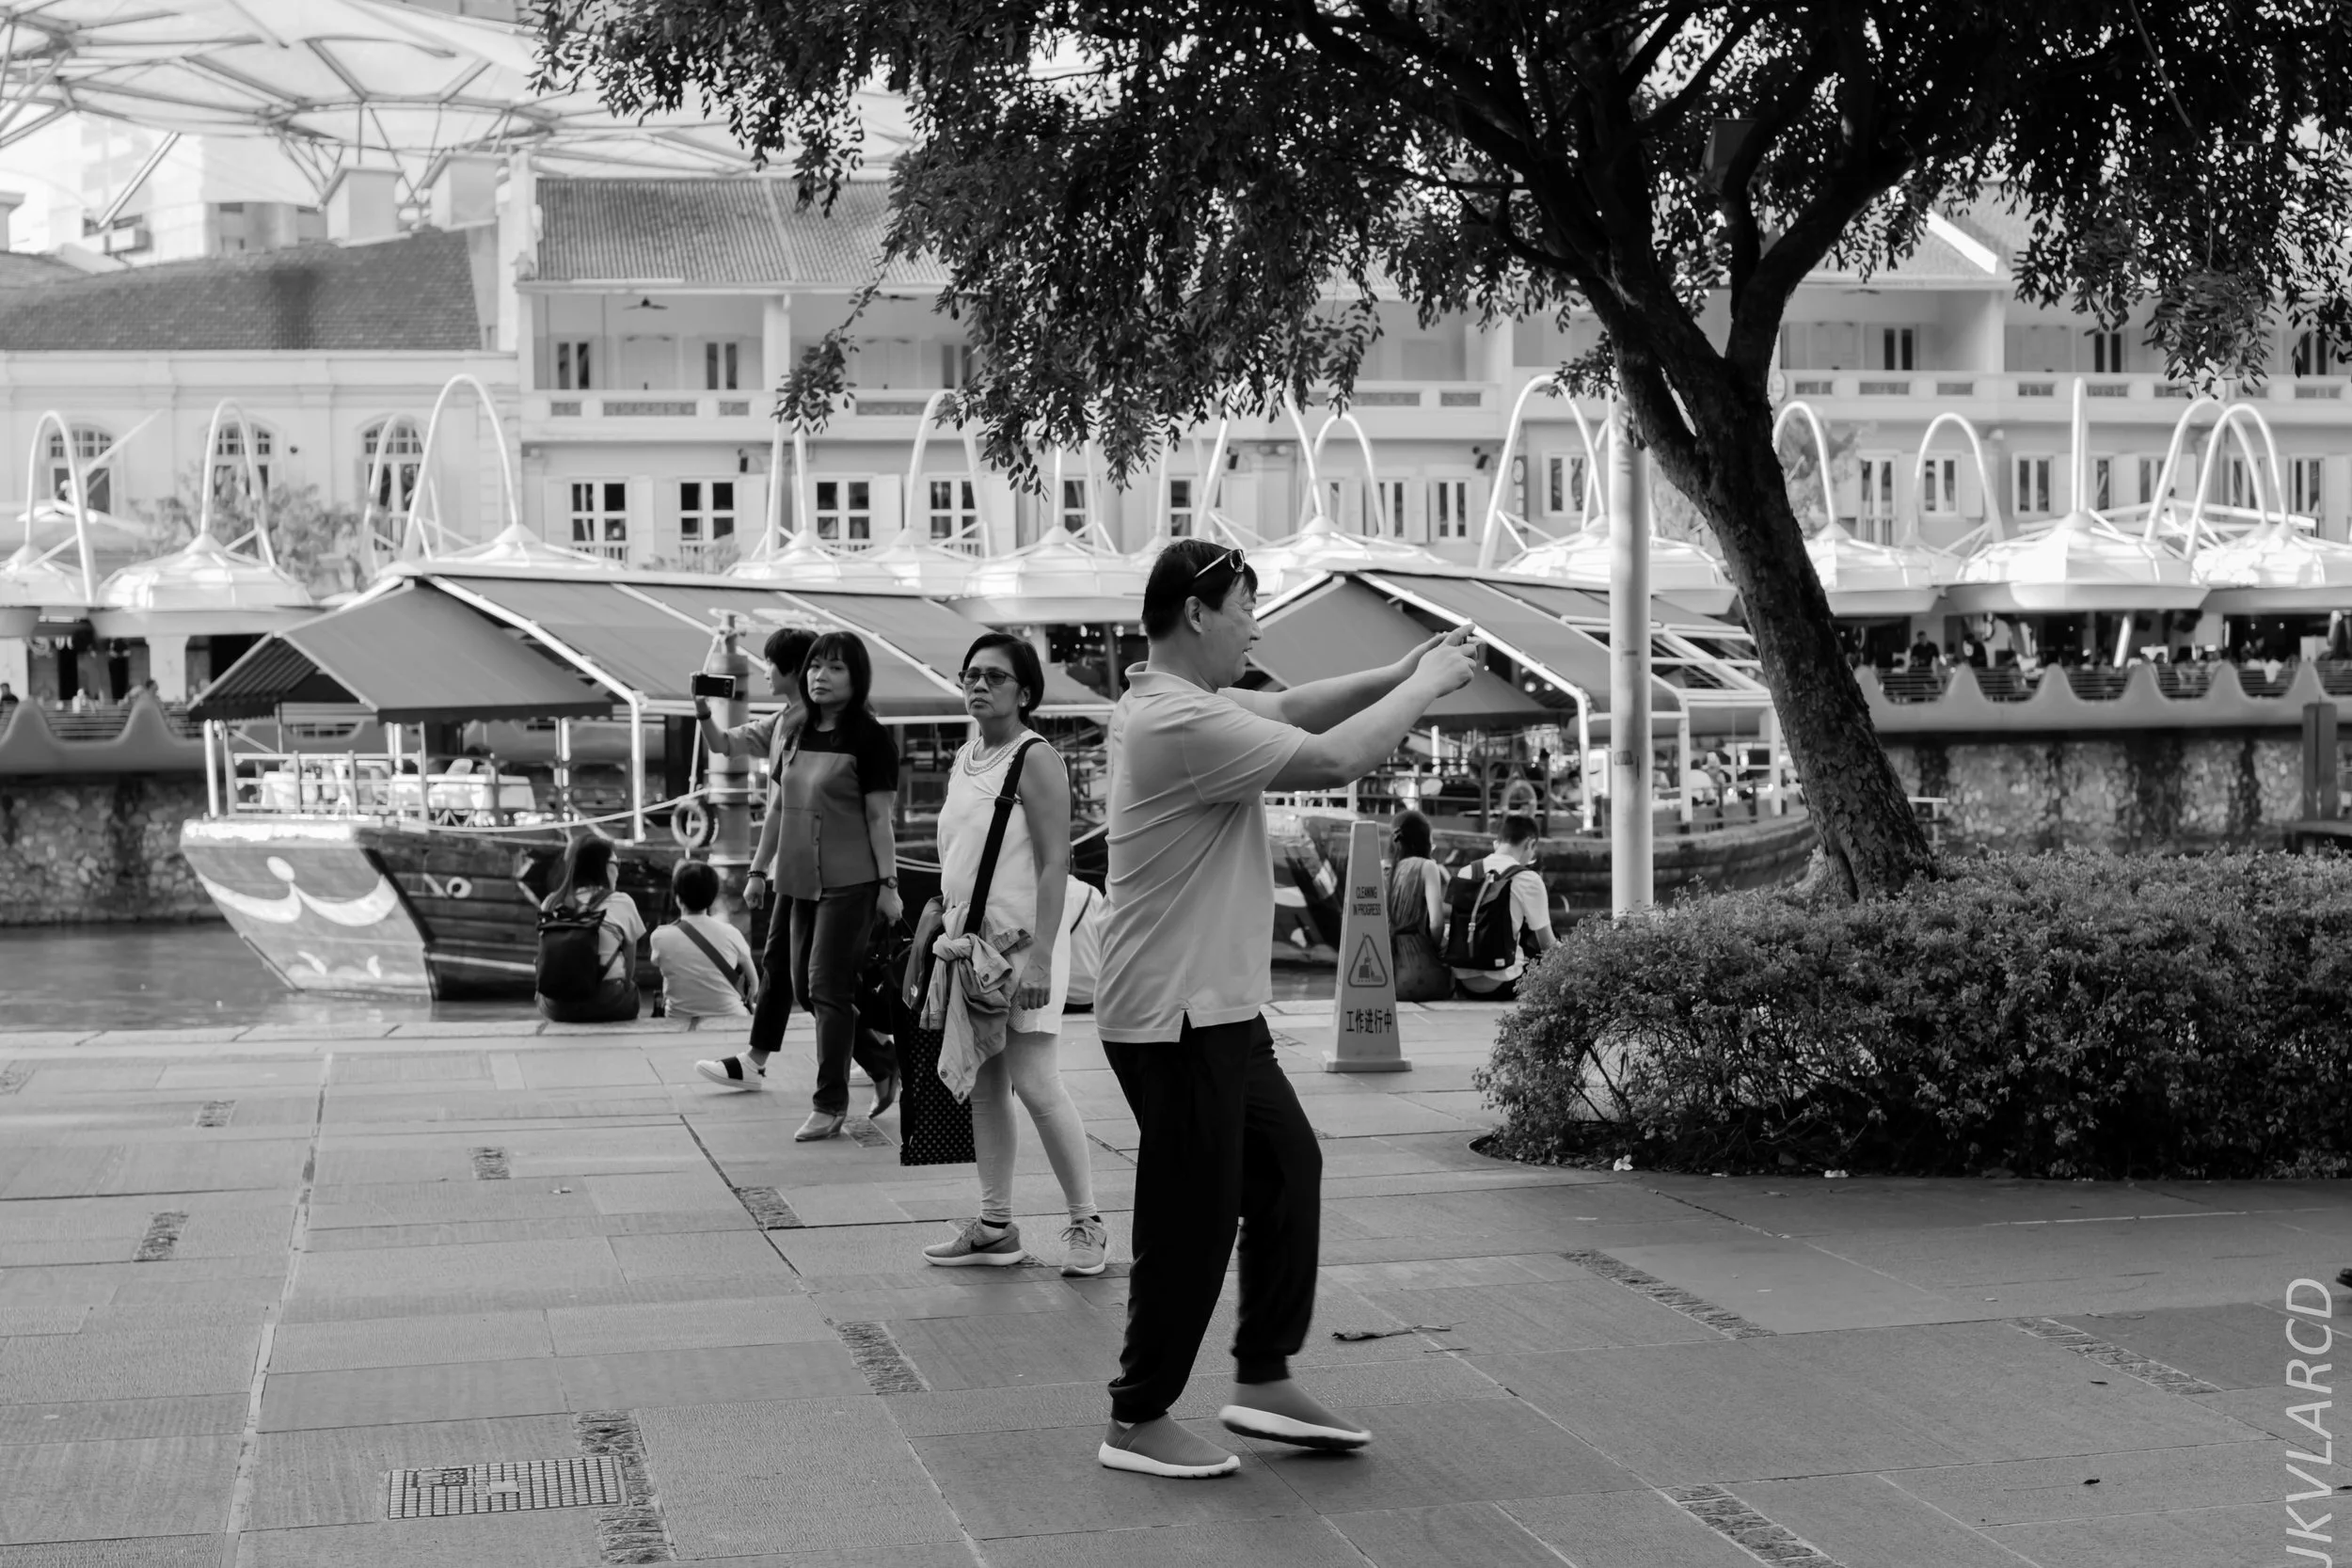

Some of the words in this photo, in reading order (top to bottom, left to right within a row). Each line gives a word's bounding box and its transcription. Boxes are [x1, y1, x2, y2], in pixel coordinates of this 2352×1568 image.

[1356, 886, 1377, 899] CLEANING
[1358, 903, 1381, 916] PROGRESS
[1346, 1008, 1392, 1034] 工作进行中
